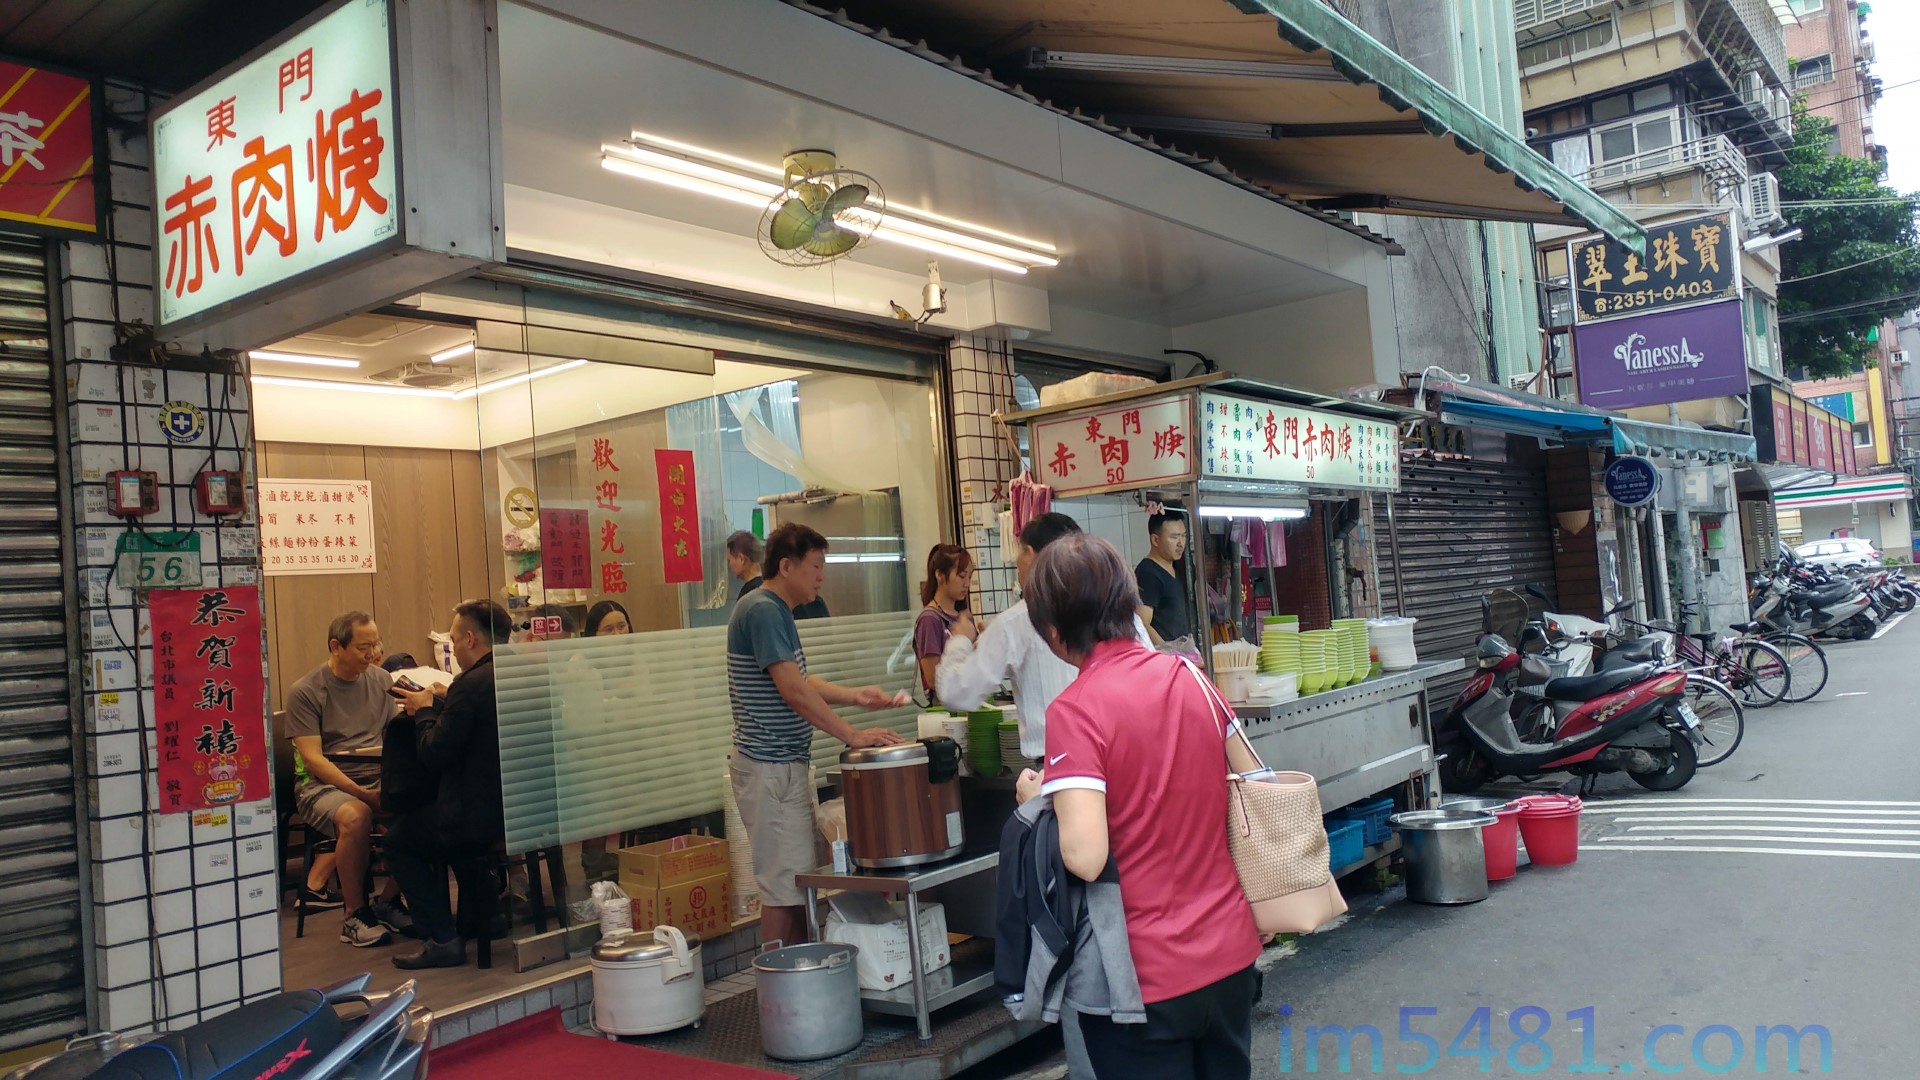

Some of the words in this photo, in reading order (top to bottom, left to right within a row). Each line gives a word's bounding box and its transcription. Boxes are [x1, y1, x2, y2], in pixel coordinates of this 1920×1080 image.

[206, 47, 313, 152] 東門
[1085, 410, 1142, 443] 東門
[1106, 466, 1125, 483] 50
[1306, 466, 1315, 479] 50
[592, 438, 628, 593] 歡迎光臨
[271, 556, 281, 565] 20
[285, 556, 294, 564] 35
[298, 556, 308, 564] 35
[311, 556, 320, 564] 35
[325, 556, 333, 564] 13
[337, 555, 346, 564] 45
[350, 555, 359, 563] 30
[136, 556, 183, 582] 56
[160, 629, 178, 700] 台北市議員
[191, 591, 246, 755] 恭賀新禧
